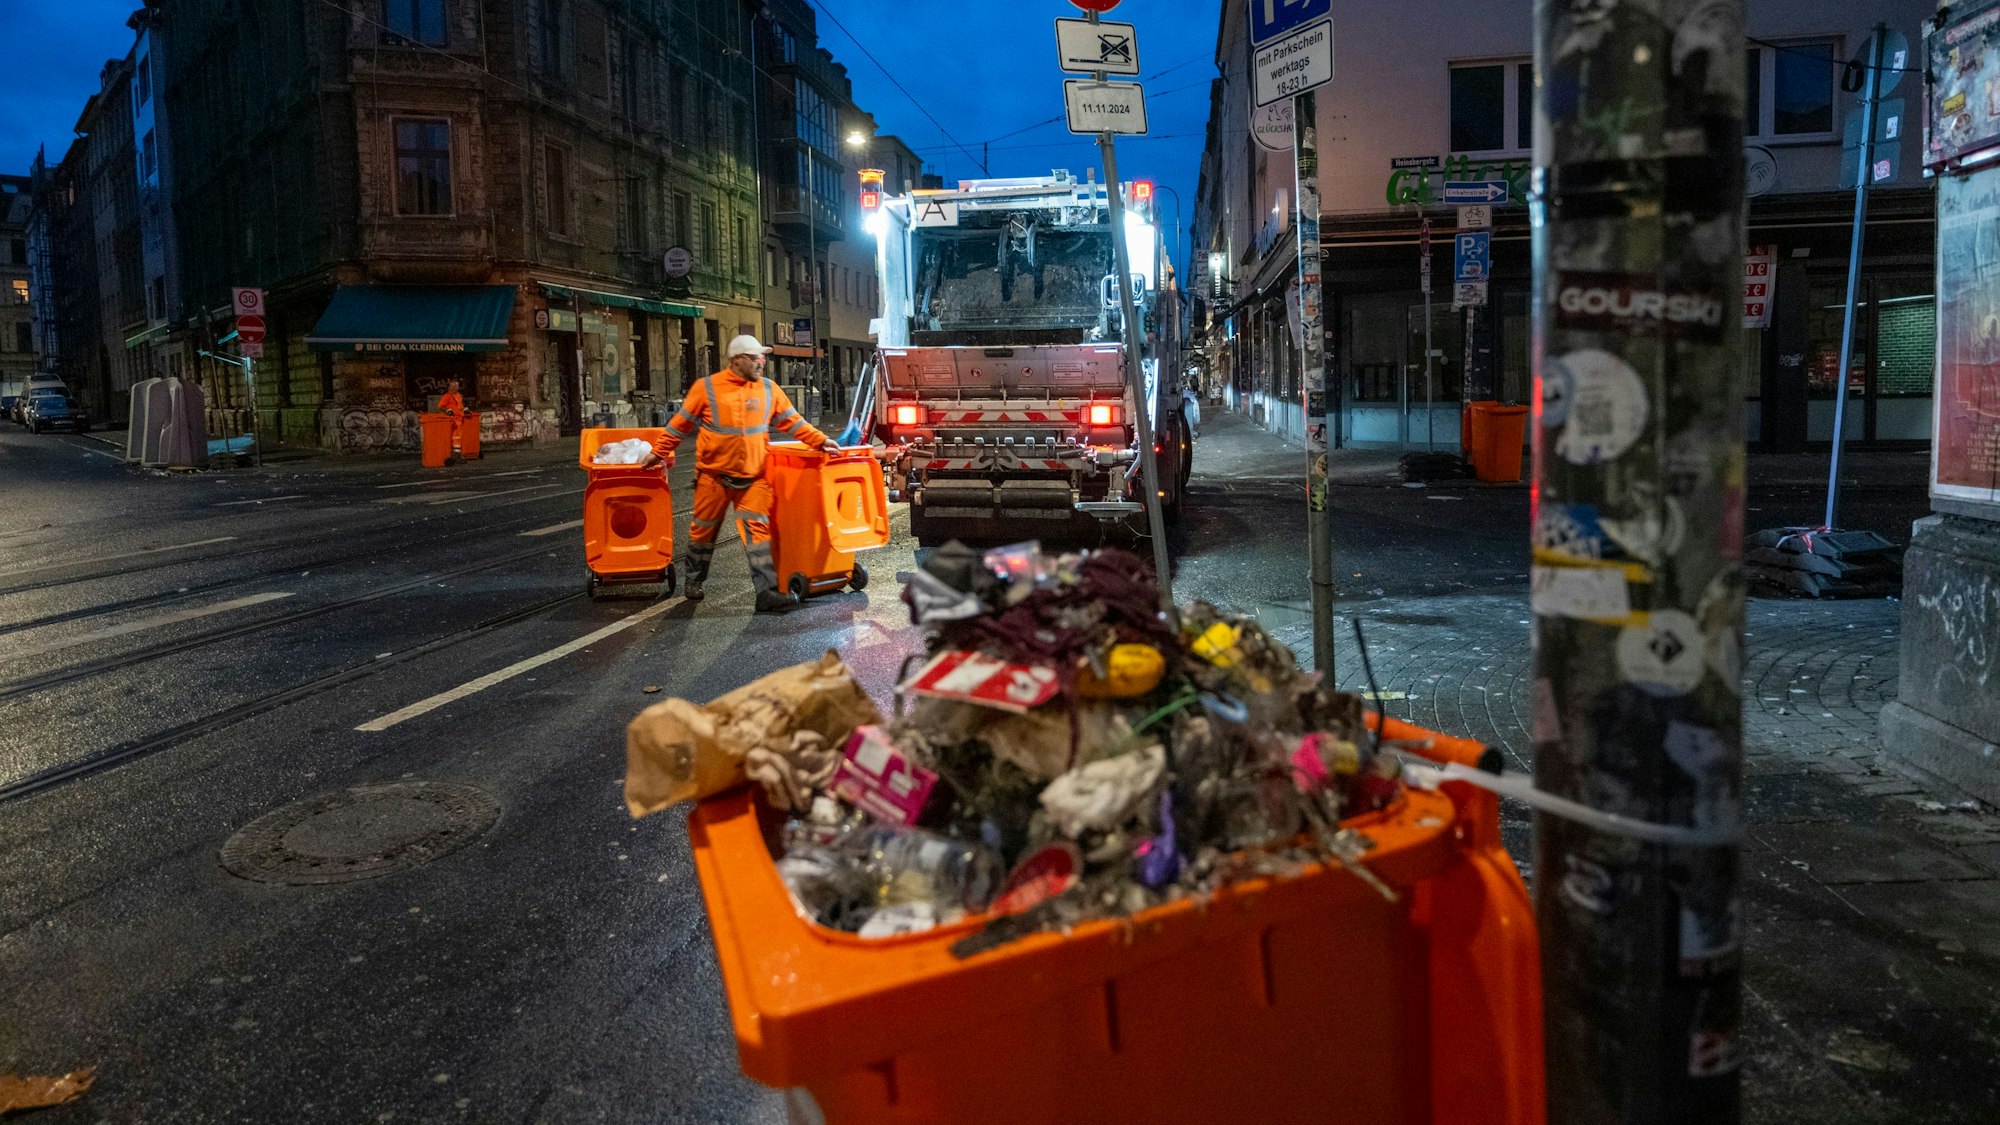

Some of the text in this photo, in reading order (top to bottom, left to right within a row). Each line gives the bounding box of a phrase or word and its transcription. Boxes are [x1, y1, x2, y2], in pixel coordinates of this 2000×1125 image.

[1258, 31, 1323, 69] mit Parkschein
[1270, 56, 1310, 80] werktags
[1277, 73, 1308, 95] 18-23 h
[1082, 103, 1130, 114] 11.11.2024
[921, 202, 947, 221] A
[1461, 236, 1475, 256] P
[242, 294, 254, 304] 30
[366, 343, 465, 352] BEI OMA KLEINMANN
